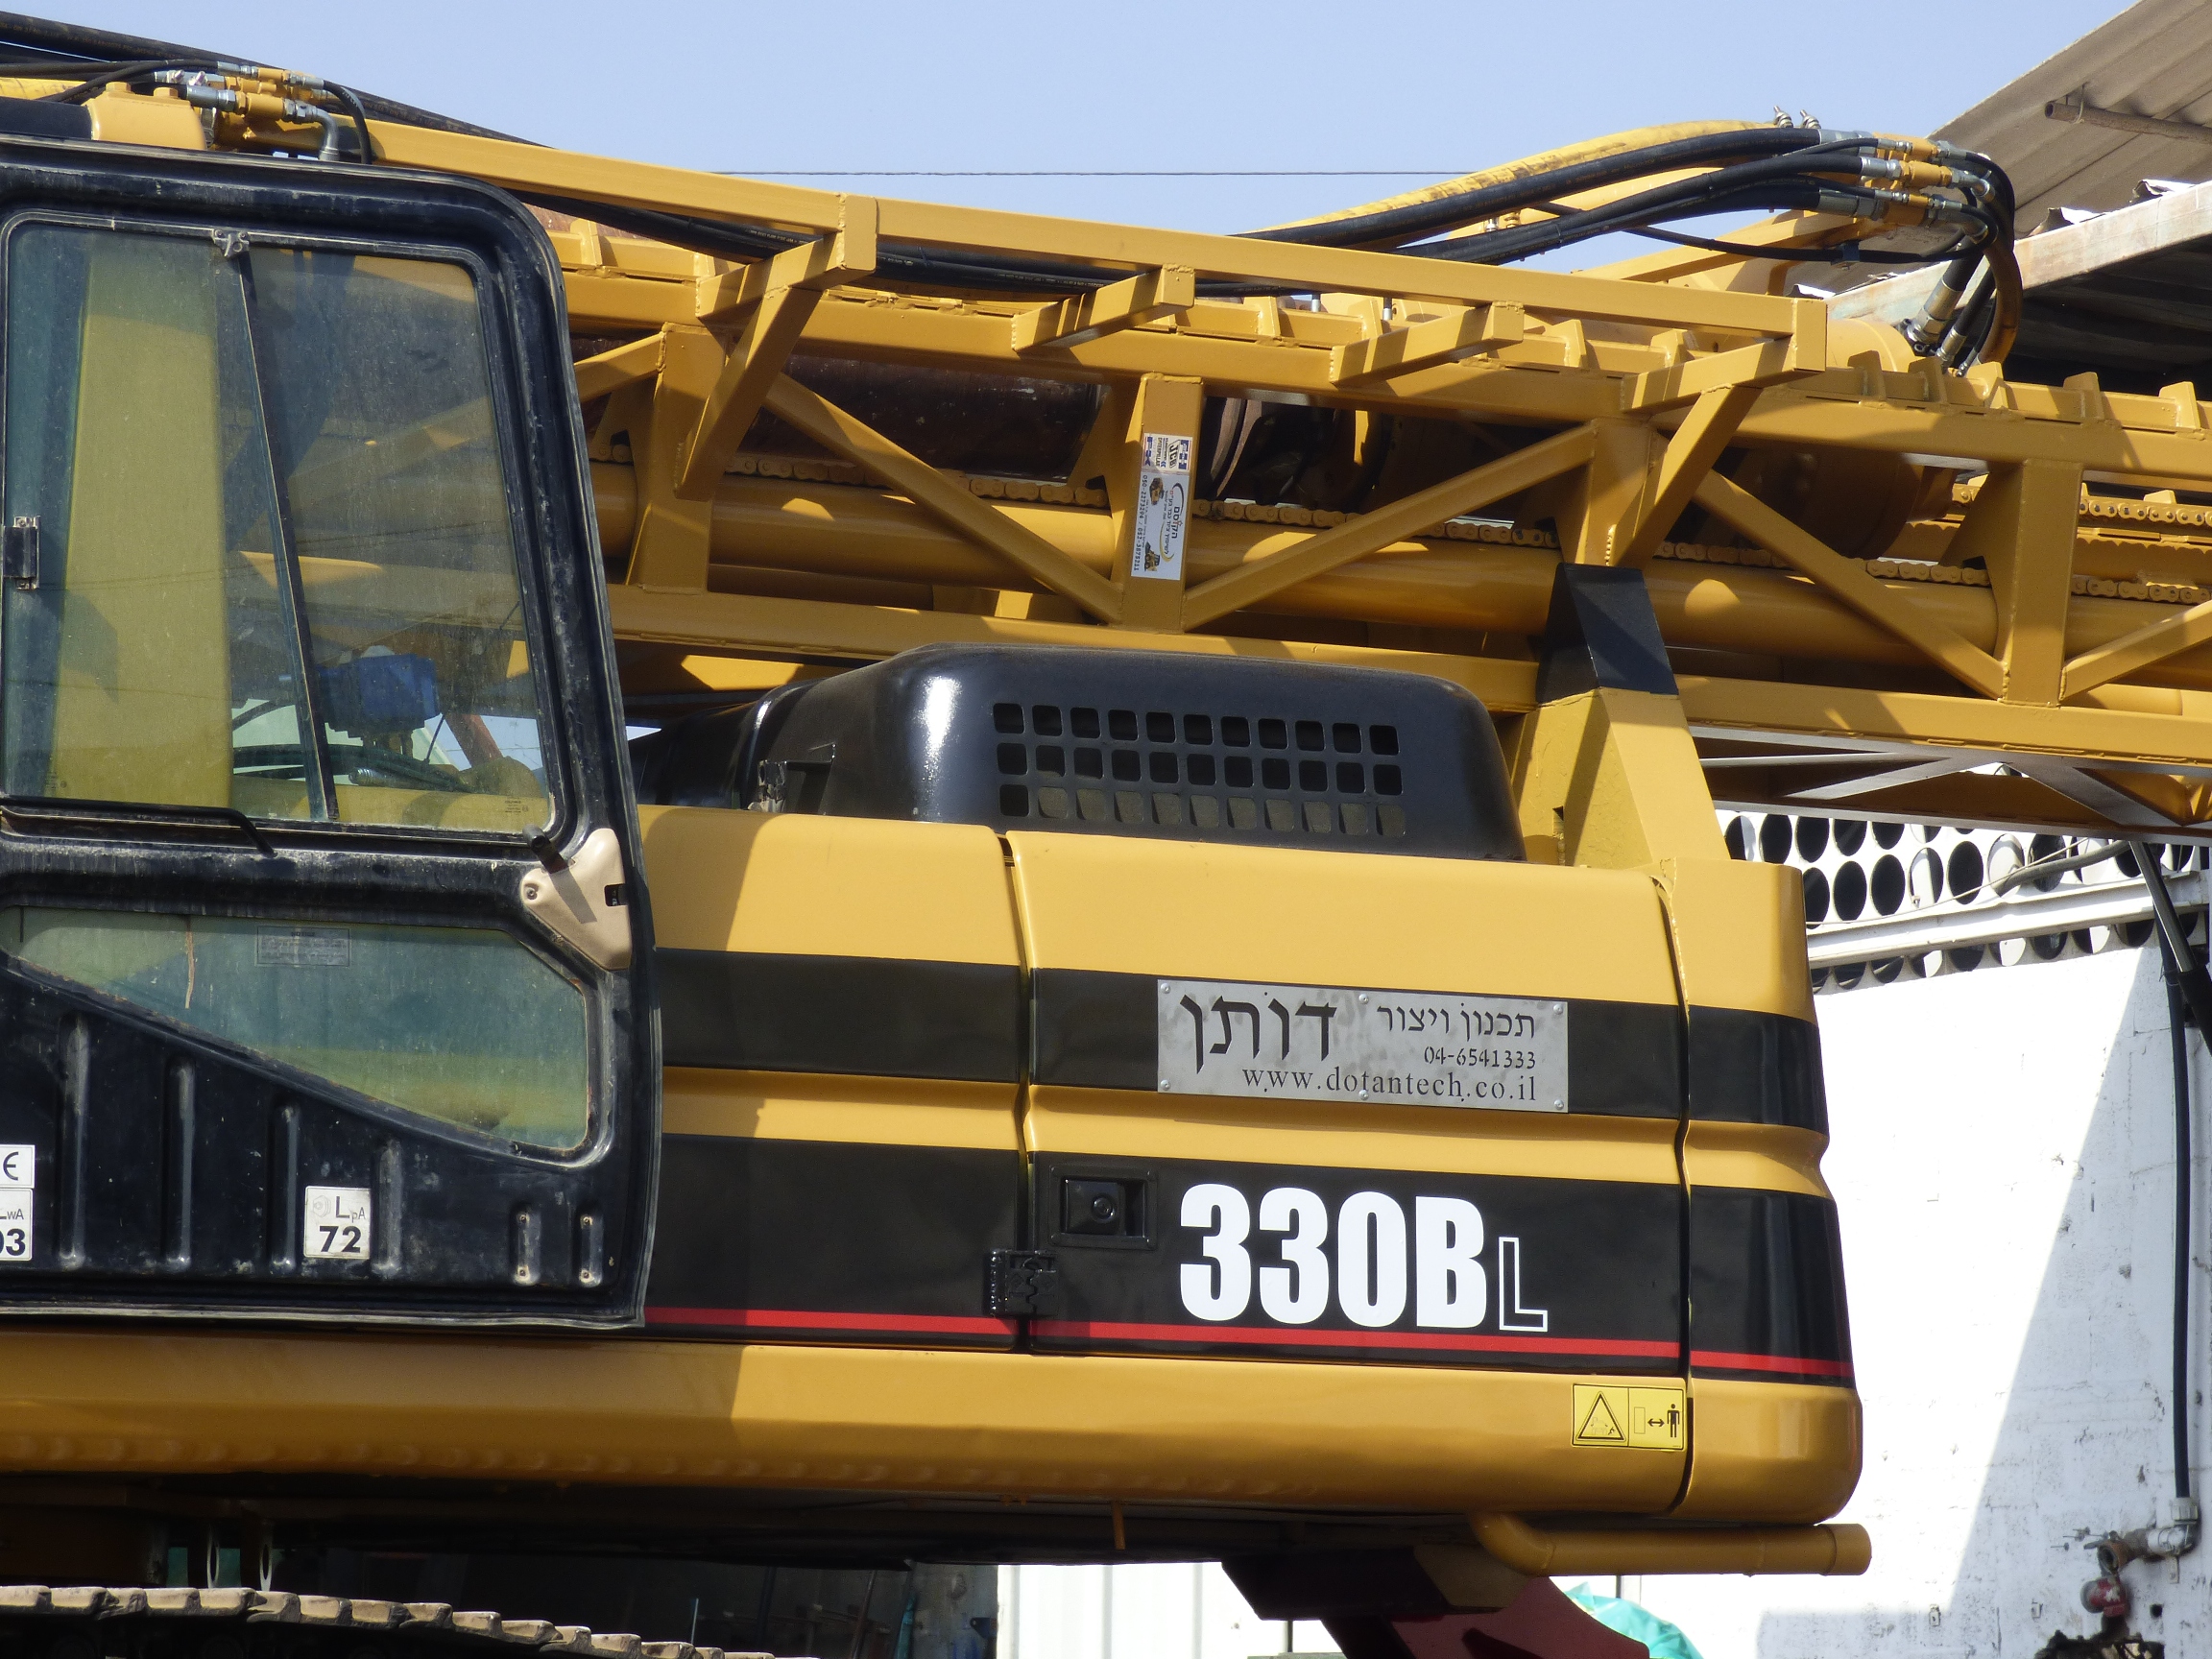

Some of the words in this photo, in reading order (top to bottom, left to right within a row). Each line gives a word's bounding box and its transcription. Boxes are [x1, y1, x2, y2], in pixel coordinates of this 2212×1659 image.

[1180, 995, 1337, 1074] דותן
[1377, 1005, 1450, 1034] ויצור
[1460, 1010, 1535, 1042] תכנון
[1424, 1046, 1536, 1070] 04-6541333
[1242, 1067, 1536, 1101] www.dotantech.co.il
[320, 1226, 361, 1253] 72
